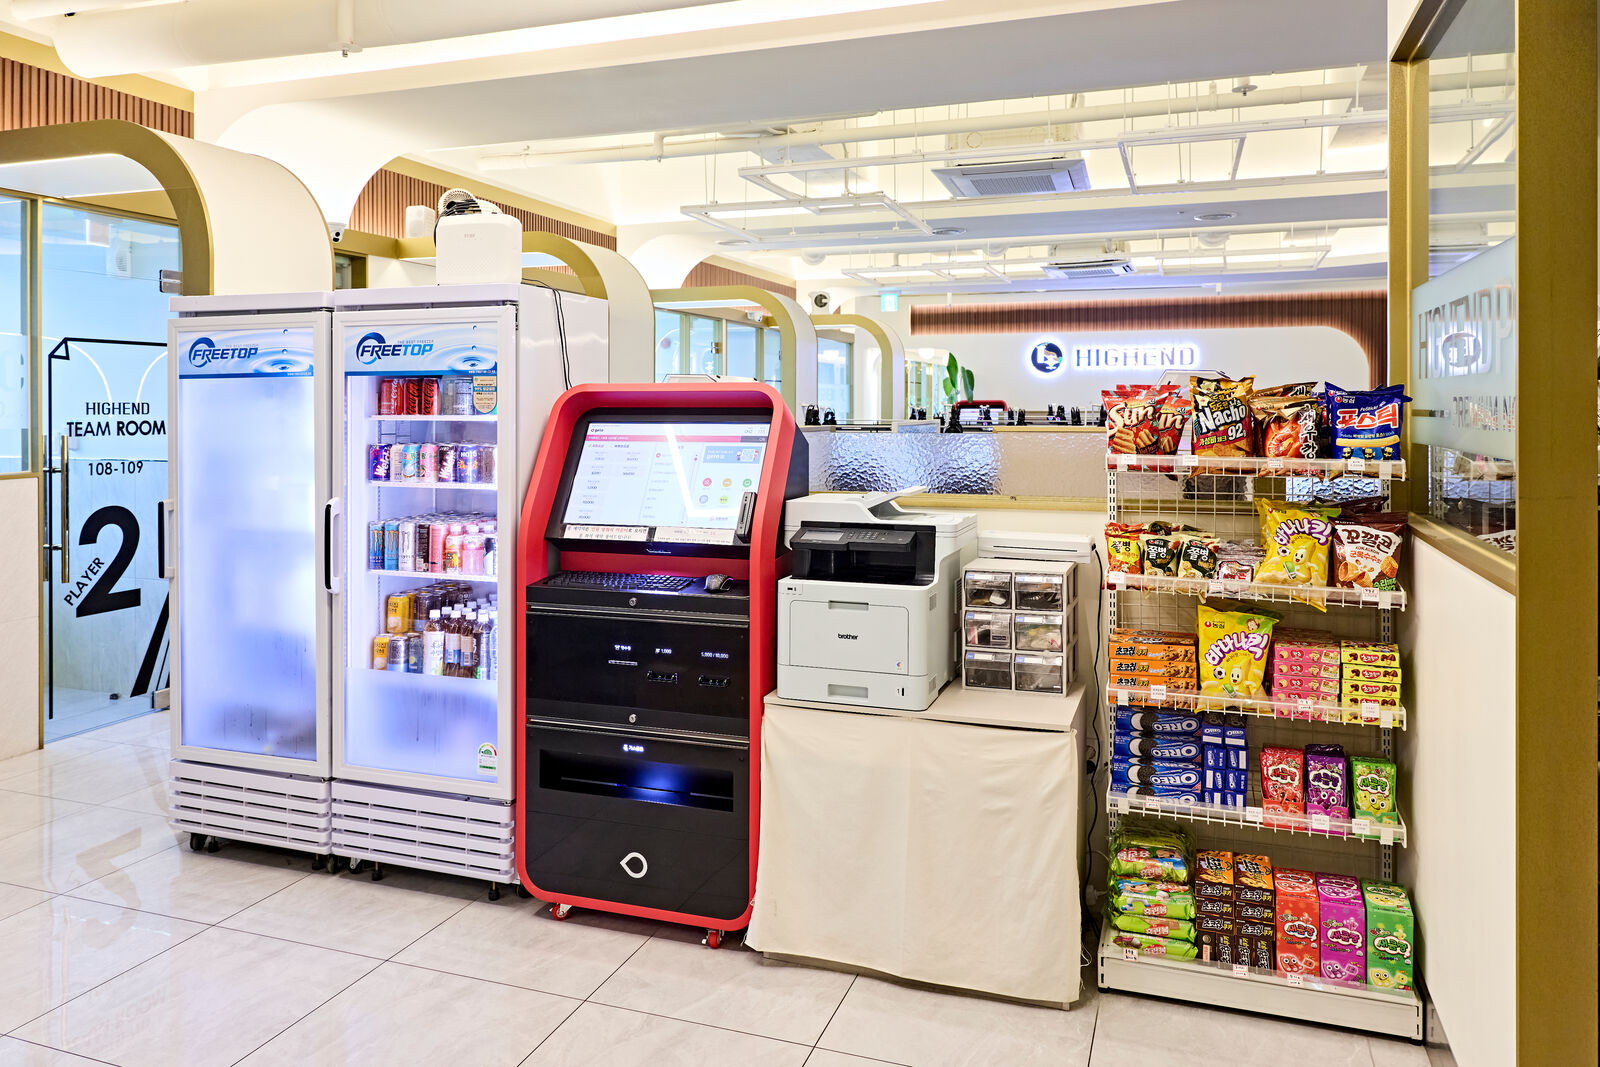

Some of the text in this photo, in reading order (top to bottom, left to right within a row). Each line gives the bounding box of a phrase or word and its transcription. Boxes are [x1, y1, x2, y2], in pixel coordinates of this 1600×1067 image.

[192, 347, 258, 363] FREETOP
[360, 343, 434, 359] FREETOP
[1076, 346, 1195, 366] HIGHEND
[85, 402, 150, 416] HIGHEND
[1337, 402, 1399, 429] 포스틱
[1107, 402, 1156, 437] Sun
[1157, 411, 1184, 431] un
[1198, 404, 1246, 434] Nacho
[67, 420, 166, 437] TEAM ROOM
[1299, 403, 1317, 459] 새우깡
[88, 461, 144, 476] 108-109
[1274, 518, 1332, 545] 바나나킥
[1341, 528, 1393, 554] 꼬깔콘
[1147, 545, 1167, 559] 쫄병
[1186, 546, 1209, 561] 쫄병
[76, 505, 141, 618] 2
[64, 556, 105, 606] PLAYER
[837, 632, 859, 641] brother
[1115, 646, 1136, 656] 초코칩
[1205, 631, 1270, 666] 바나나킥
[1116, 662, 1137, 672] 초코칩
[1116, 677, 1137, 686] 초코칩
[1153, 718, 1199, 731] OREO
[1152, 744, 1198, 757] OREO
[1151, 771, 1198, 785] OREO
[1201, 885, 1222, 896] 초코칩
[1241, 890, 1262, 901] 초코칩
[1201, 902, 1222, 912] 초코칩
[1241, 906, 1263, 918] 초코칩
[1202, 919, 1223, 929] 초코칩
[1241, 924, 1263, 935] 초코칩
[1377, 938, 1409, 953] 새콤짱
